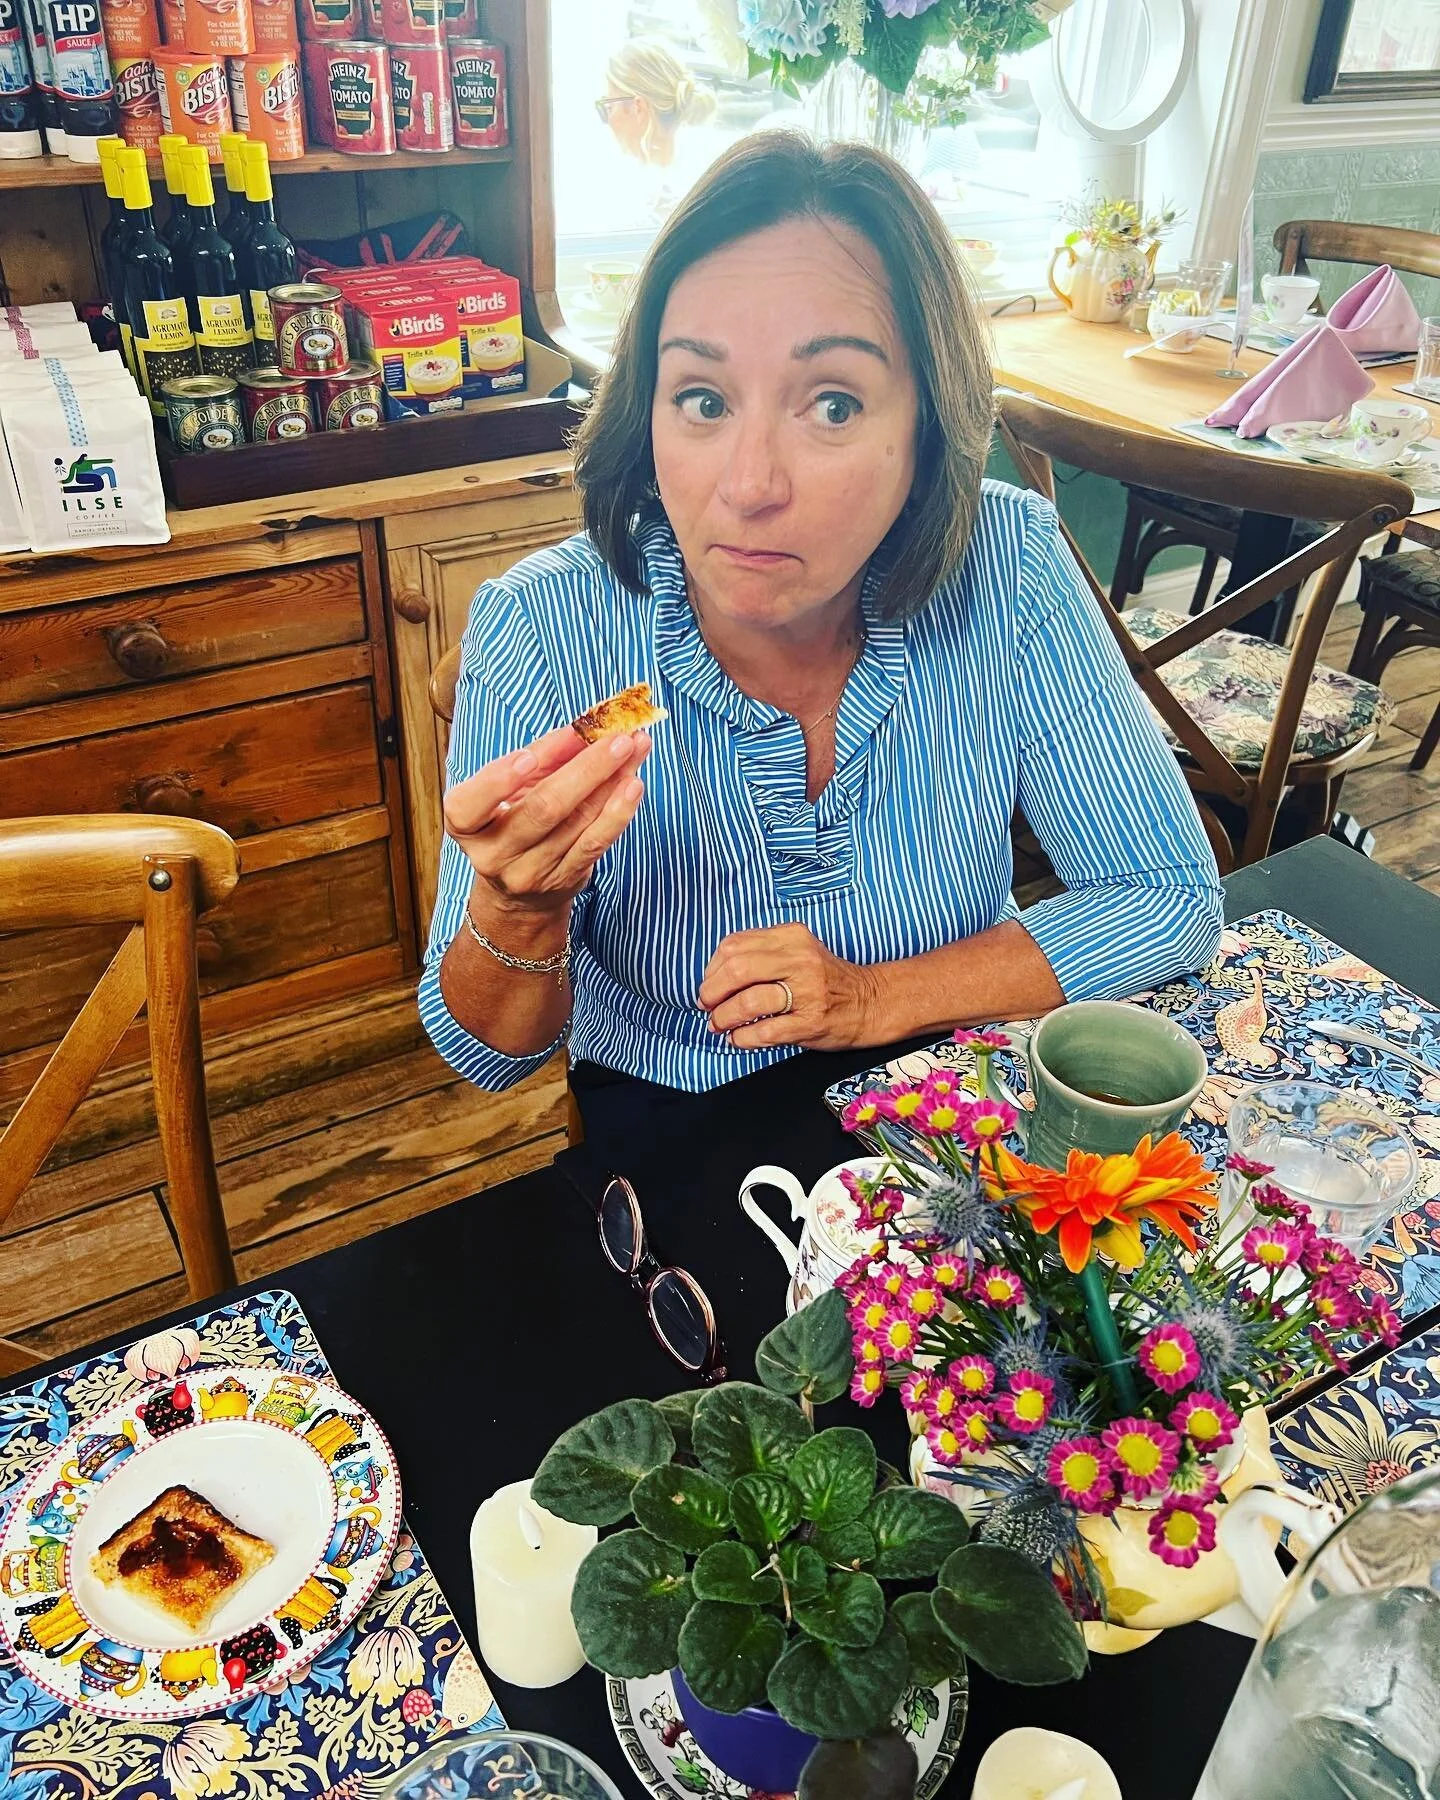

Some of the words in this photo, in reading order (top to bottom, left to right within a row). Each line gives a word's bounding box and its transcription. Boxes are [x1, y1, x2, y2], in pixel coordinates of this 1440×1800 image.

[53, 4, 96, 32] HP
[66, 38, 92, 48] SAUCE
[332, 64, 364, 79] HEINZ
[457, 60, 490, 75] HEINZ
[184, 75, 227, 114] BISTO
[331, 88, 371, 104] TOMATO
[456, 85, 495, 98] TOMATO
[465, 291, 507, 314] Bird's
[152, 320, 188, 333] AGRUMATO
[205, 317, 242, 328] AGRUMATO
[290, 313, 327, 333] BLACK
[400, 312, 445, 336] Bird's
[160, 331, 184, 340] LEMON
[213, 327, 238, 336] LEMON
[339, 388, 372, 409] BLACK
[264, 398, 300, 418] BLACK
[62, 496, 123, 511] ILSE
